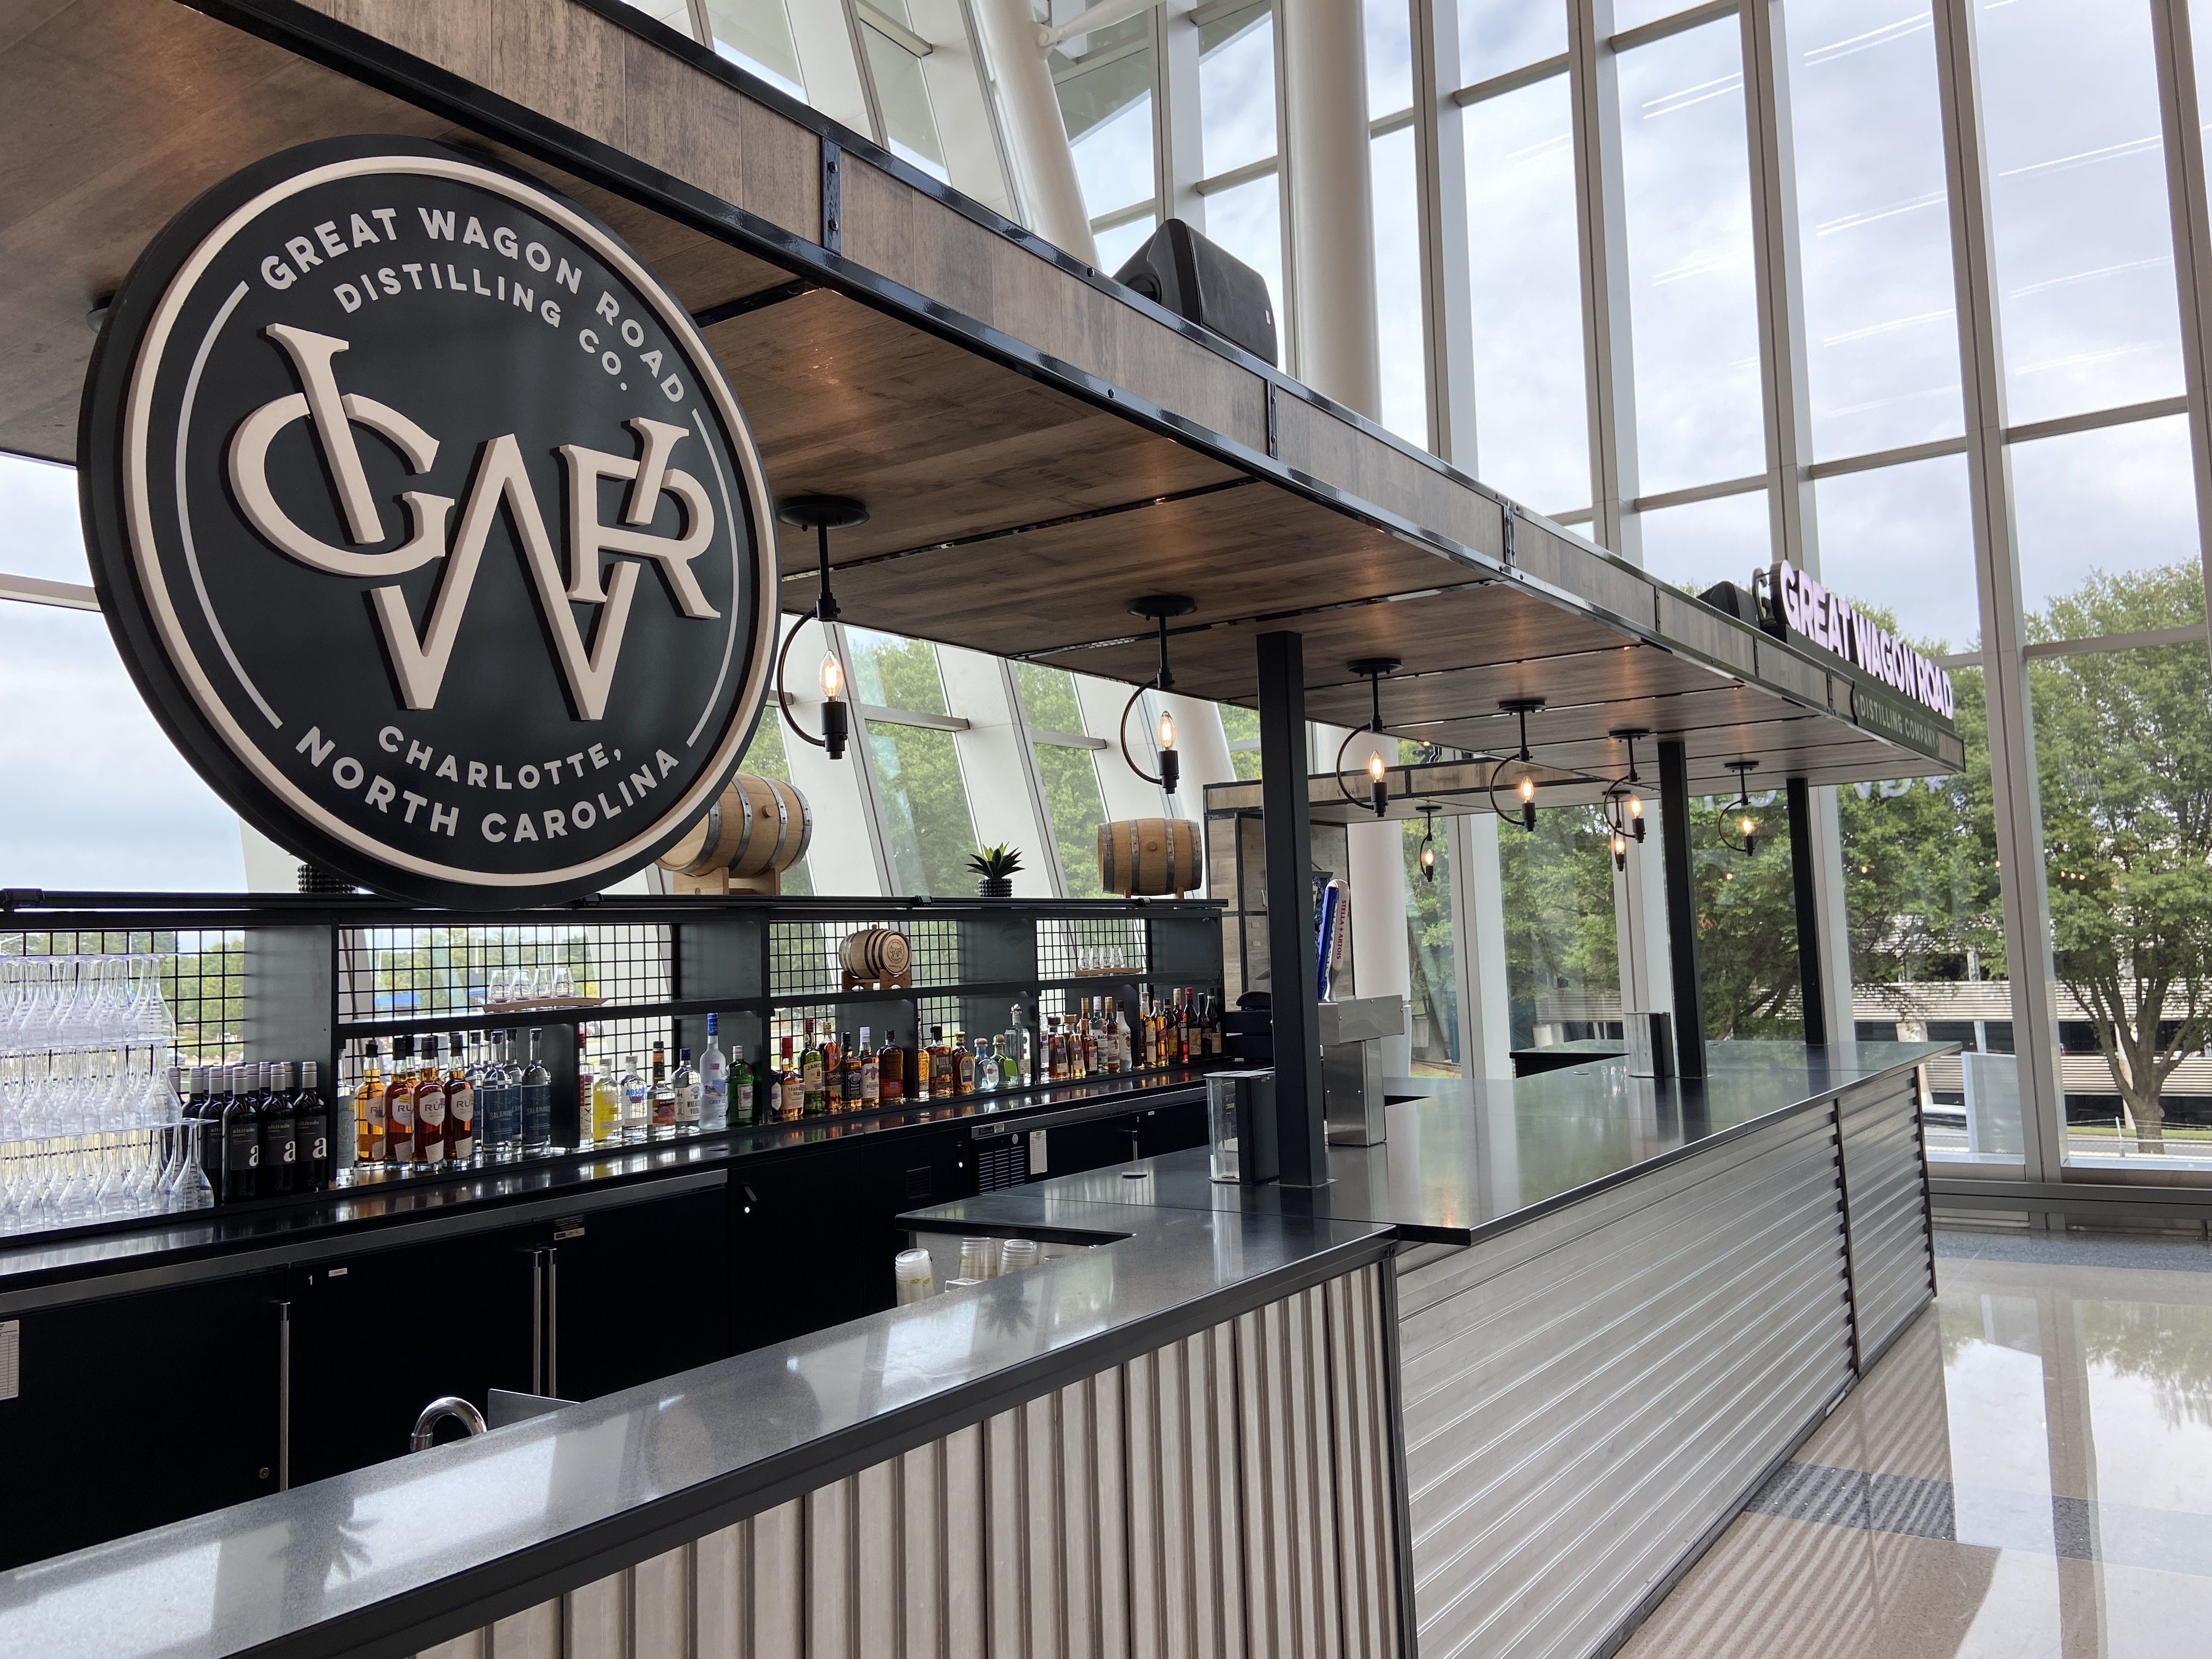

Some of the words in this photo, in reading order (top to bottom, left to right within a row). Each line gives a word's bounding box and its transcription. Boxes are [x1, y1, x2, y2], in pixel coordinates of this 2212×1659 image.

[261, 207, 400, 290] GREAT
[418, 207, 583, 294] WAGON
[596, 290, 685, 403] ROAD
[335, 263, 561, 327] DISTILLING
[579, 328, 627, 392] CO.
[1780, 559, 1850, 662] GREAT
[1852, 609, 1917, 700] WAGON
[1914, 652, 1954, 720] ROAD
[1859, 694, 1903, 735] DISTILLING
[1905, 717, 1936, 749] COMPANY
[295, 725, 459, 838] NORTH
[481, 746, 680, 844] CAROLINA
[378, 724, 623, 791] CHARLOTTE,
[283, 1141, 296, 1163] a
[312, 1137, 327, 1158] a
[308, 1275, 313, 1285] 1
